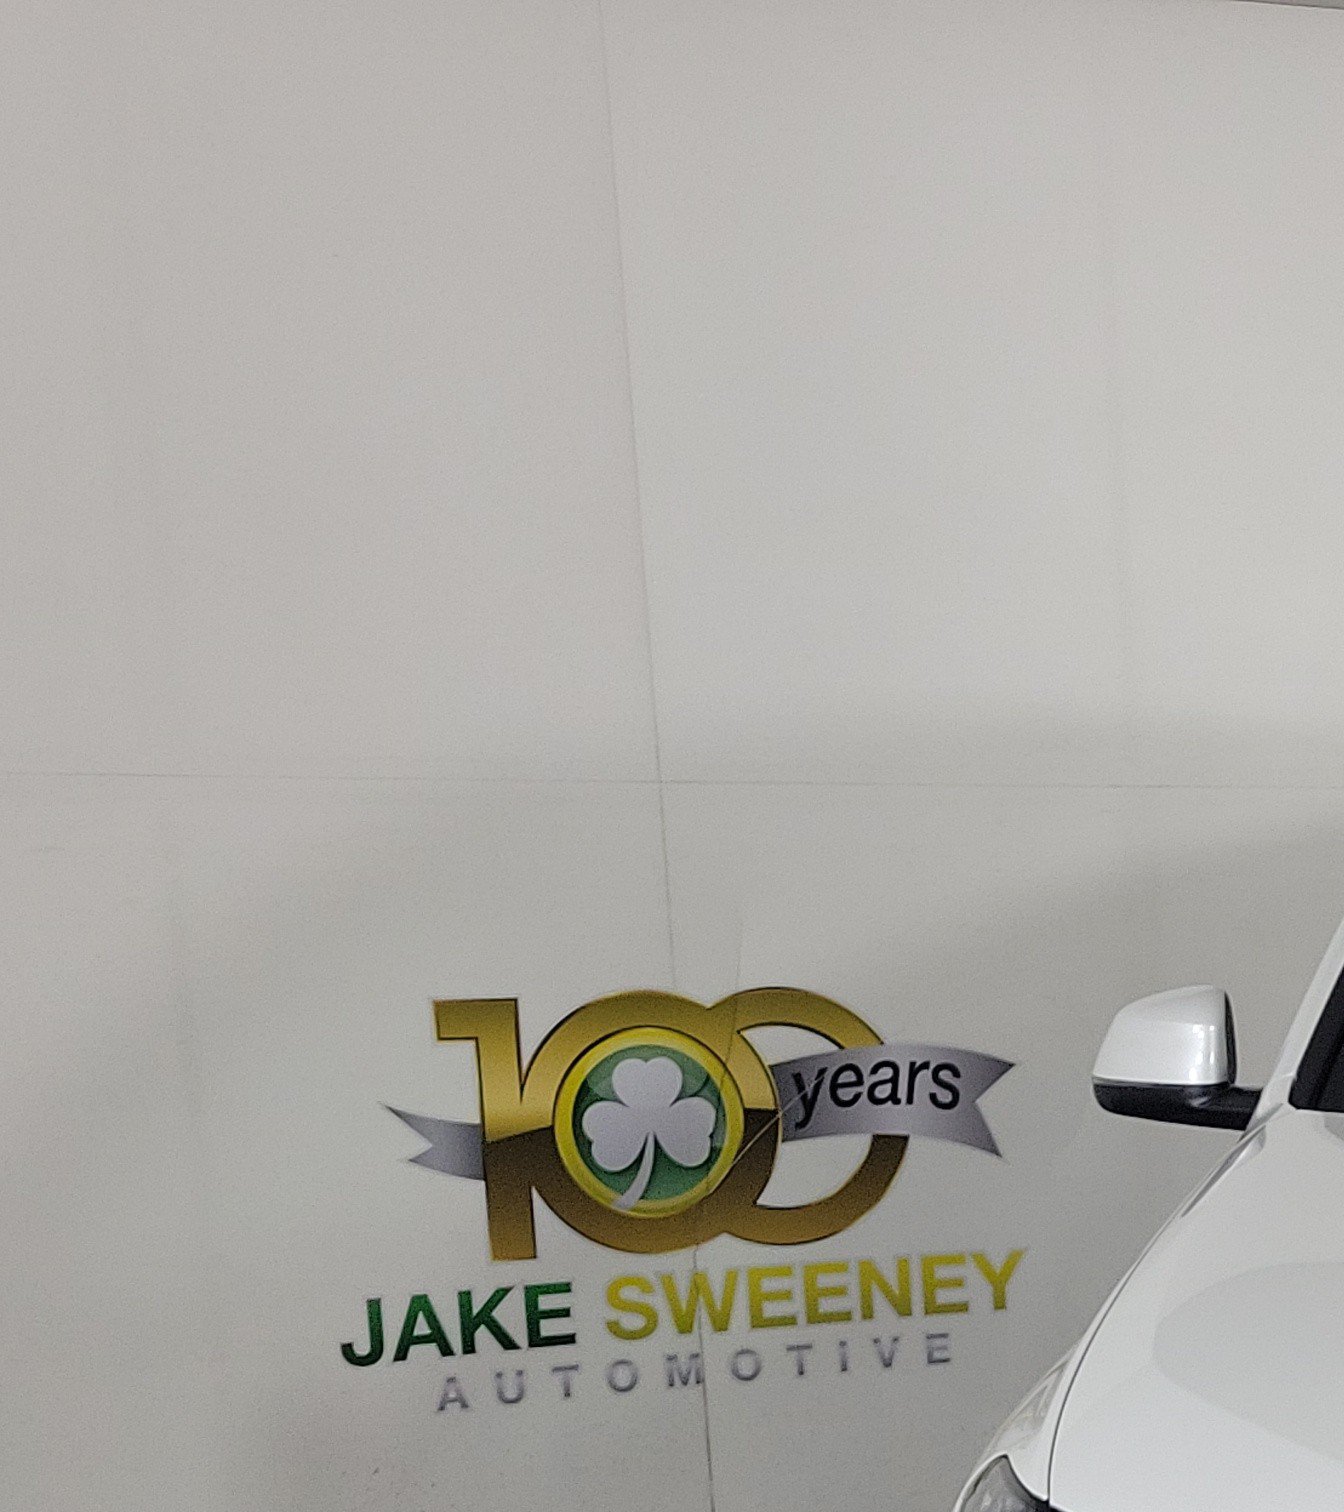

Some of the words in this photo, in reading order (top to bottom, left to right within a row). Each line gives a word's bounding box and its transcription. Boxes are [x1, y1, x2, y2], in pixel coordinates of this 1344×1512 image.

[433, 986, 909, 1261] 100
[791, 1059, 962, 1129] years
[340, 1281, 577, 1367] JAKE
[605, 1249, 1026, 1341] SWEENEY
[437, 1331, 952, 1412] AUTOMOTIVE
